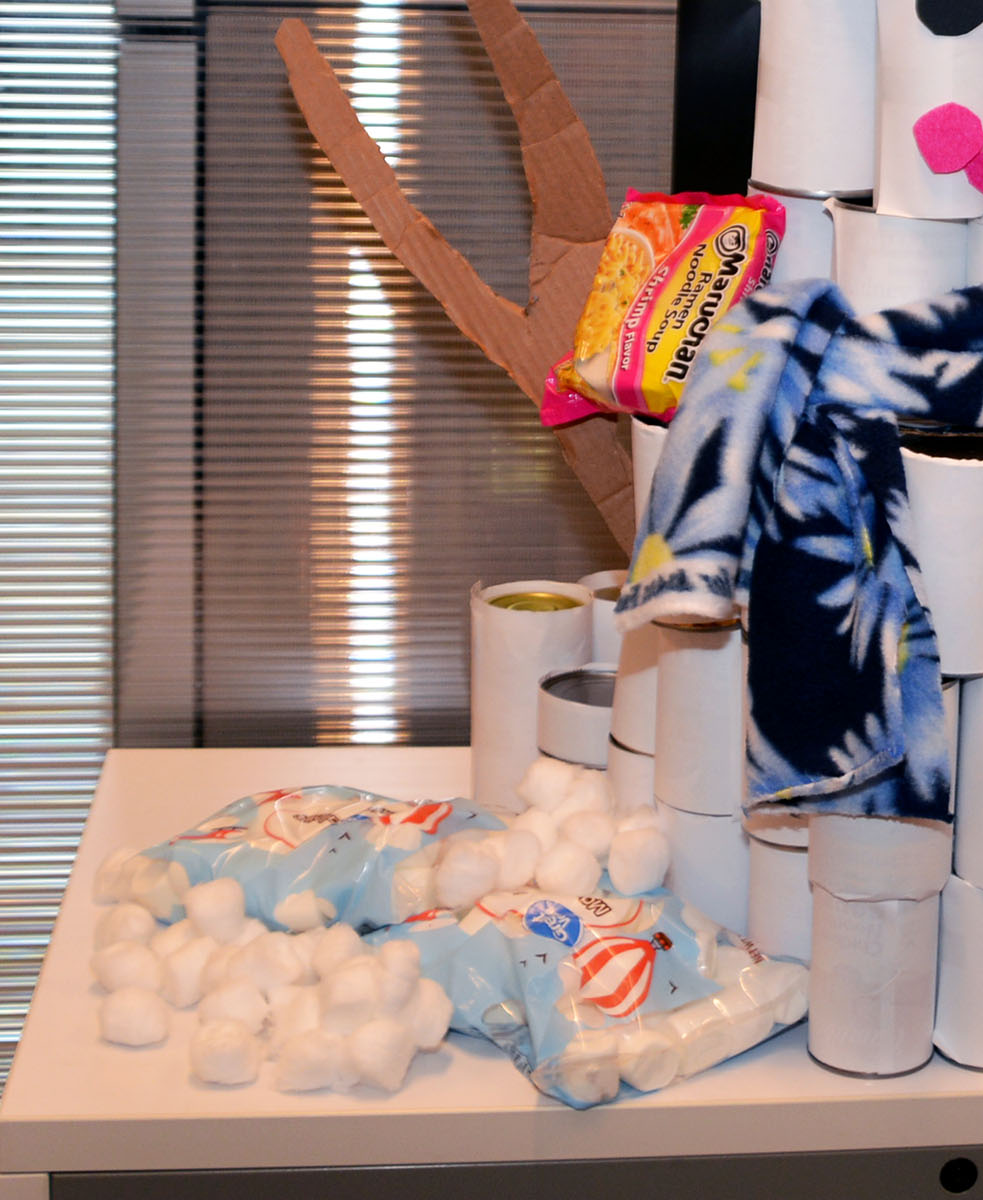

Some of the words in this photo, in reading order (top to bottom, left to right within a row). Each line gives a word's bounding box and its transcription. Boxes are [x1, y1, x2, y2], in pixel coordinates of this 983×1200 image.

[624, 265, 669, 330] Shrimp
[671, 243, 707, 306] Noodle
[672, 272, 712, 330] Ramen
[646, 309, 678, 353] Soup
[666, 252, 748, 382] Maruchan
[621, 331, 636, 371] Flavor
